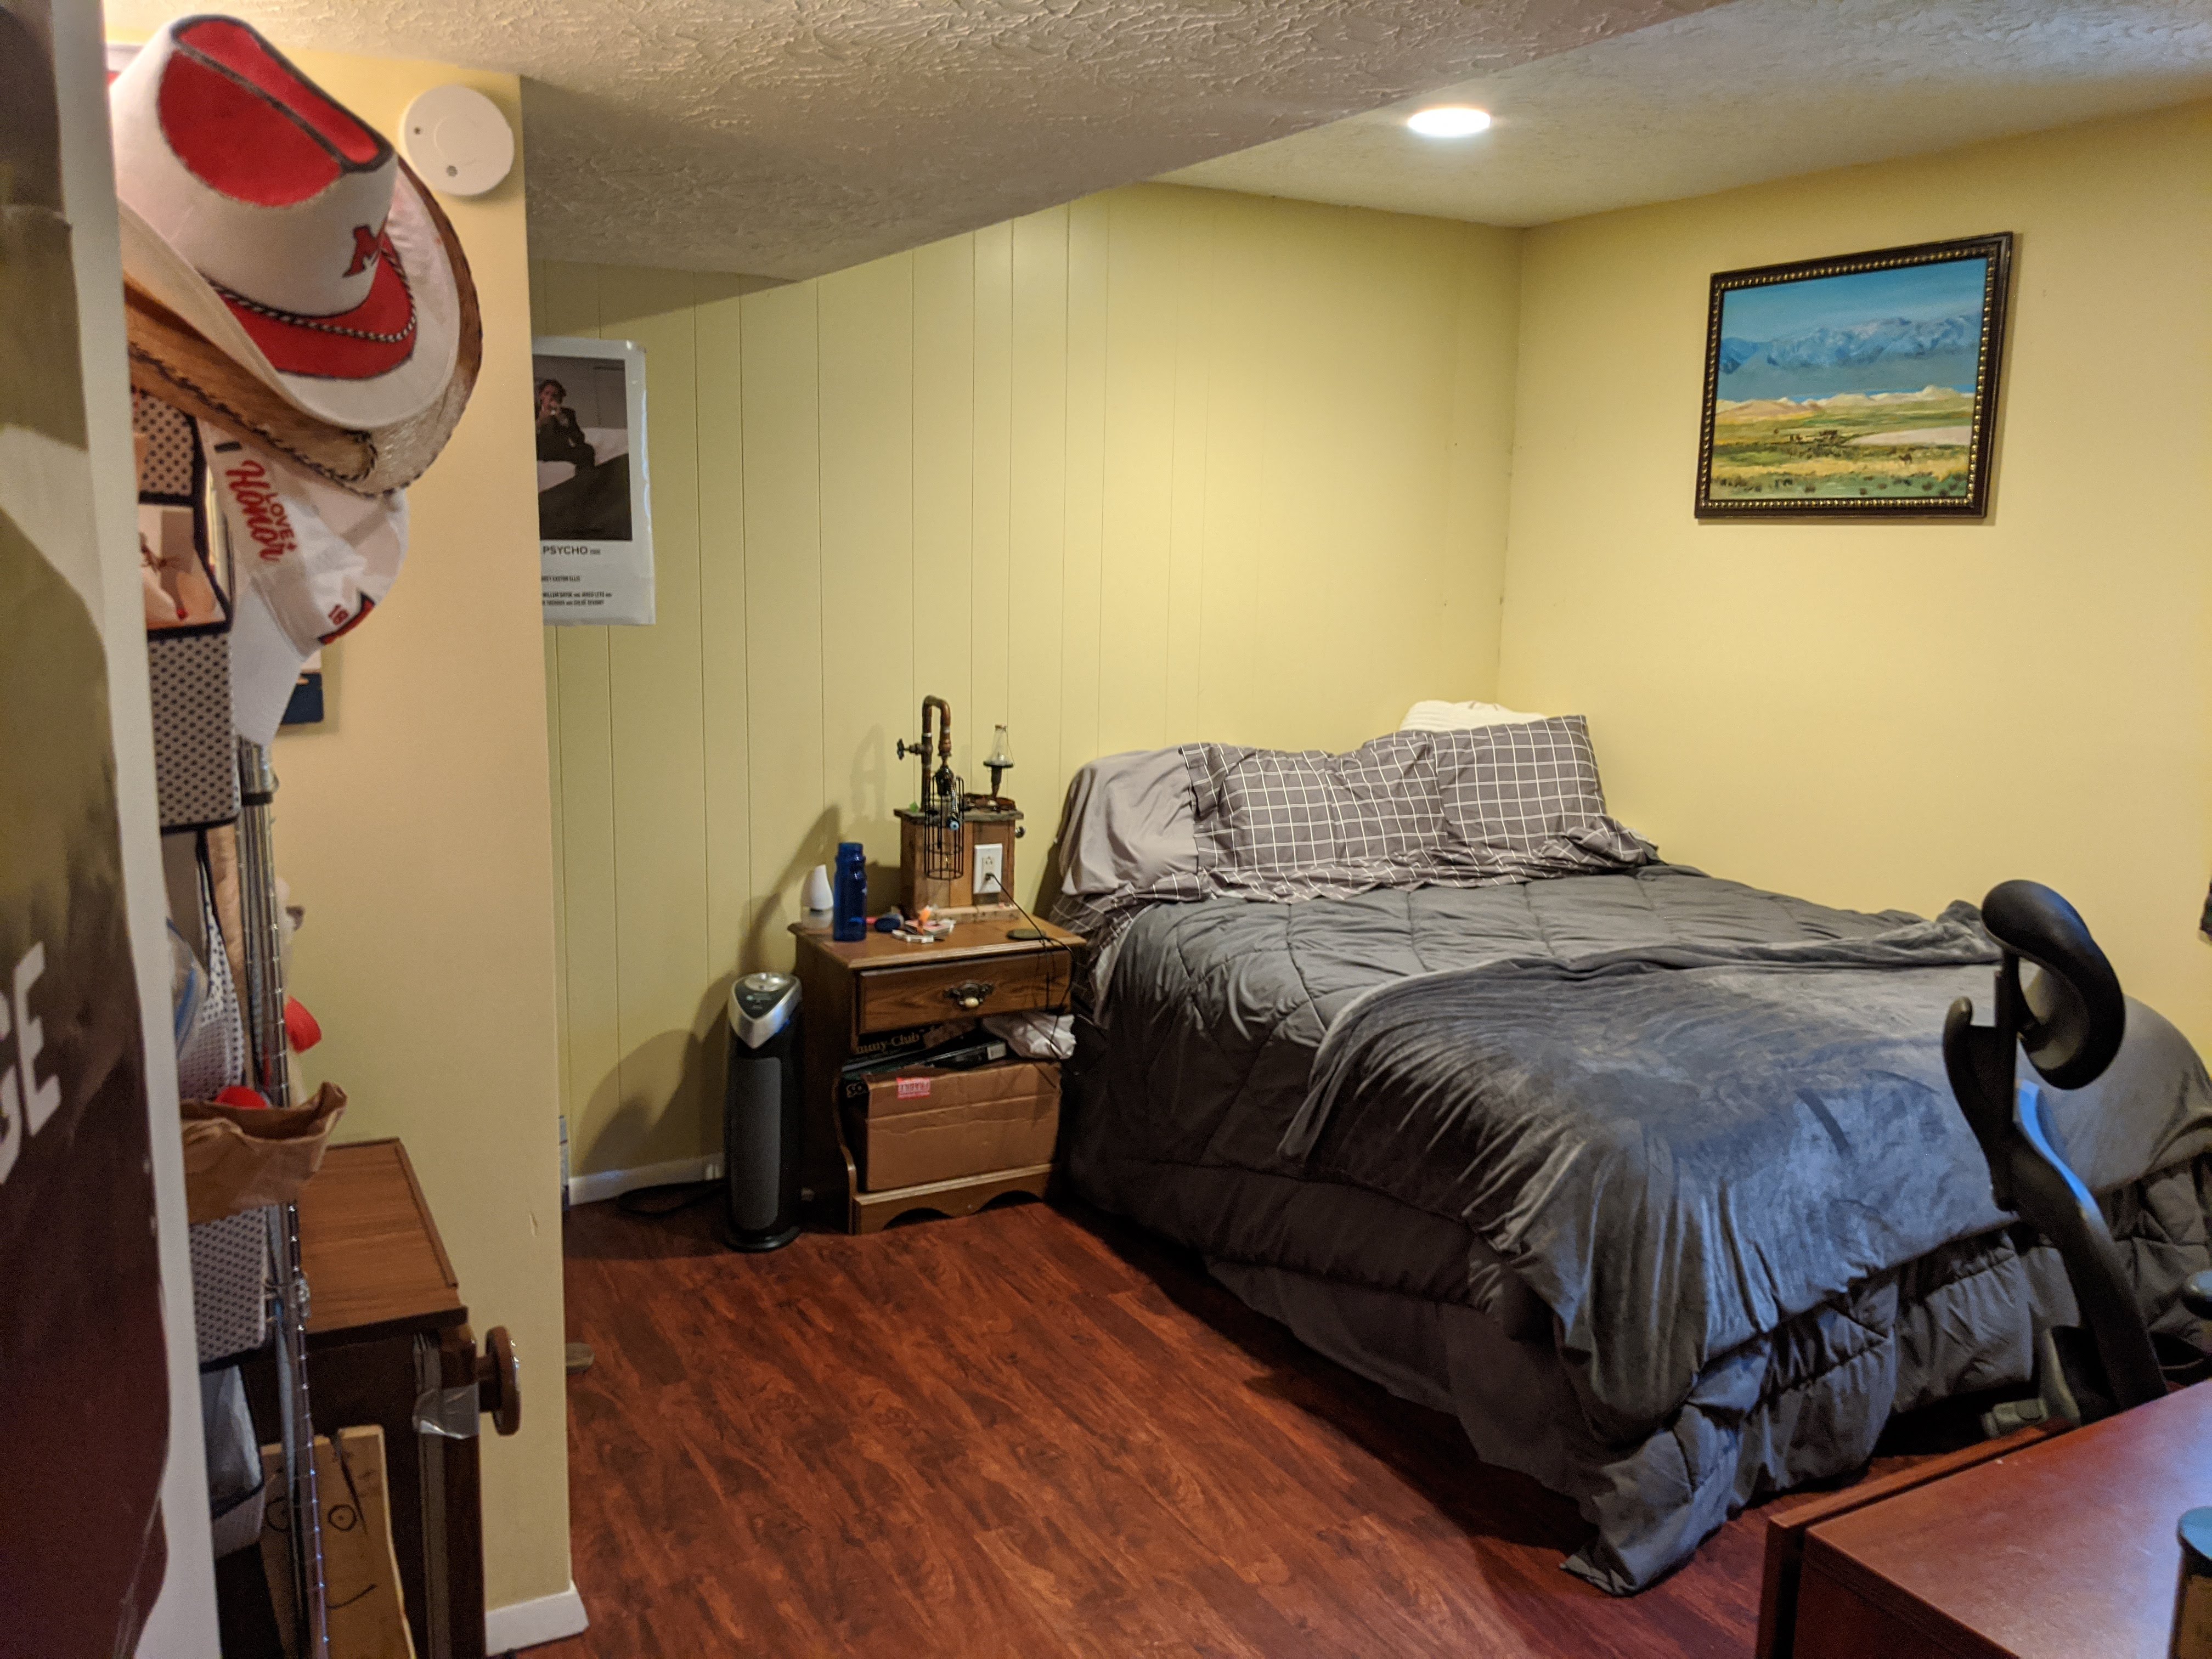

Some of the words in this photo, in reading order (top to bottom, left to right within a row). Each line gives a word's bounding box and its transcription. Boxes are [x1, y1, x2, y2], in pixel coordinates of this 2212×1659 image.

[225, 460, 285, 562] Honor
[264, 493, 295, 540] LOVE
[543, 545, 588, 555] PSYCHO
